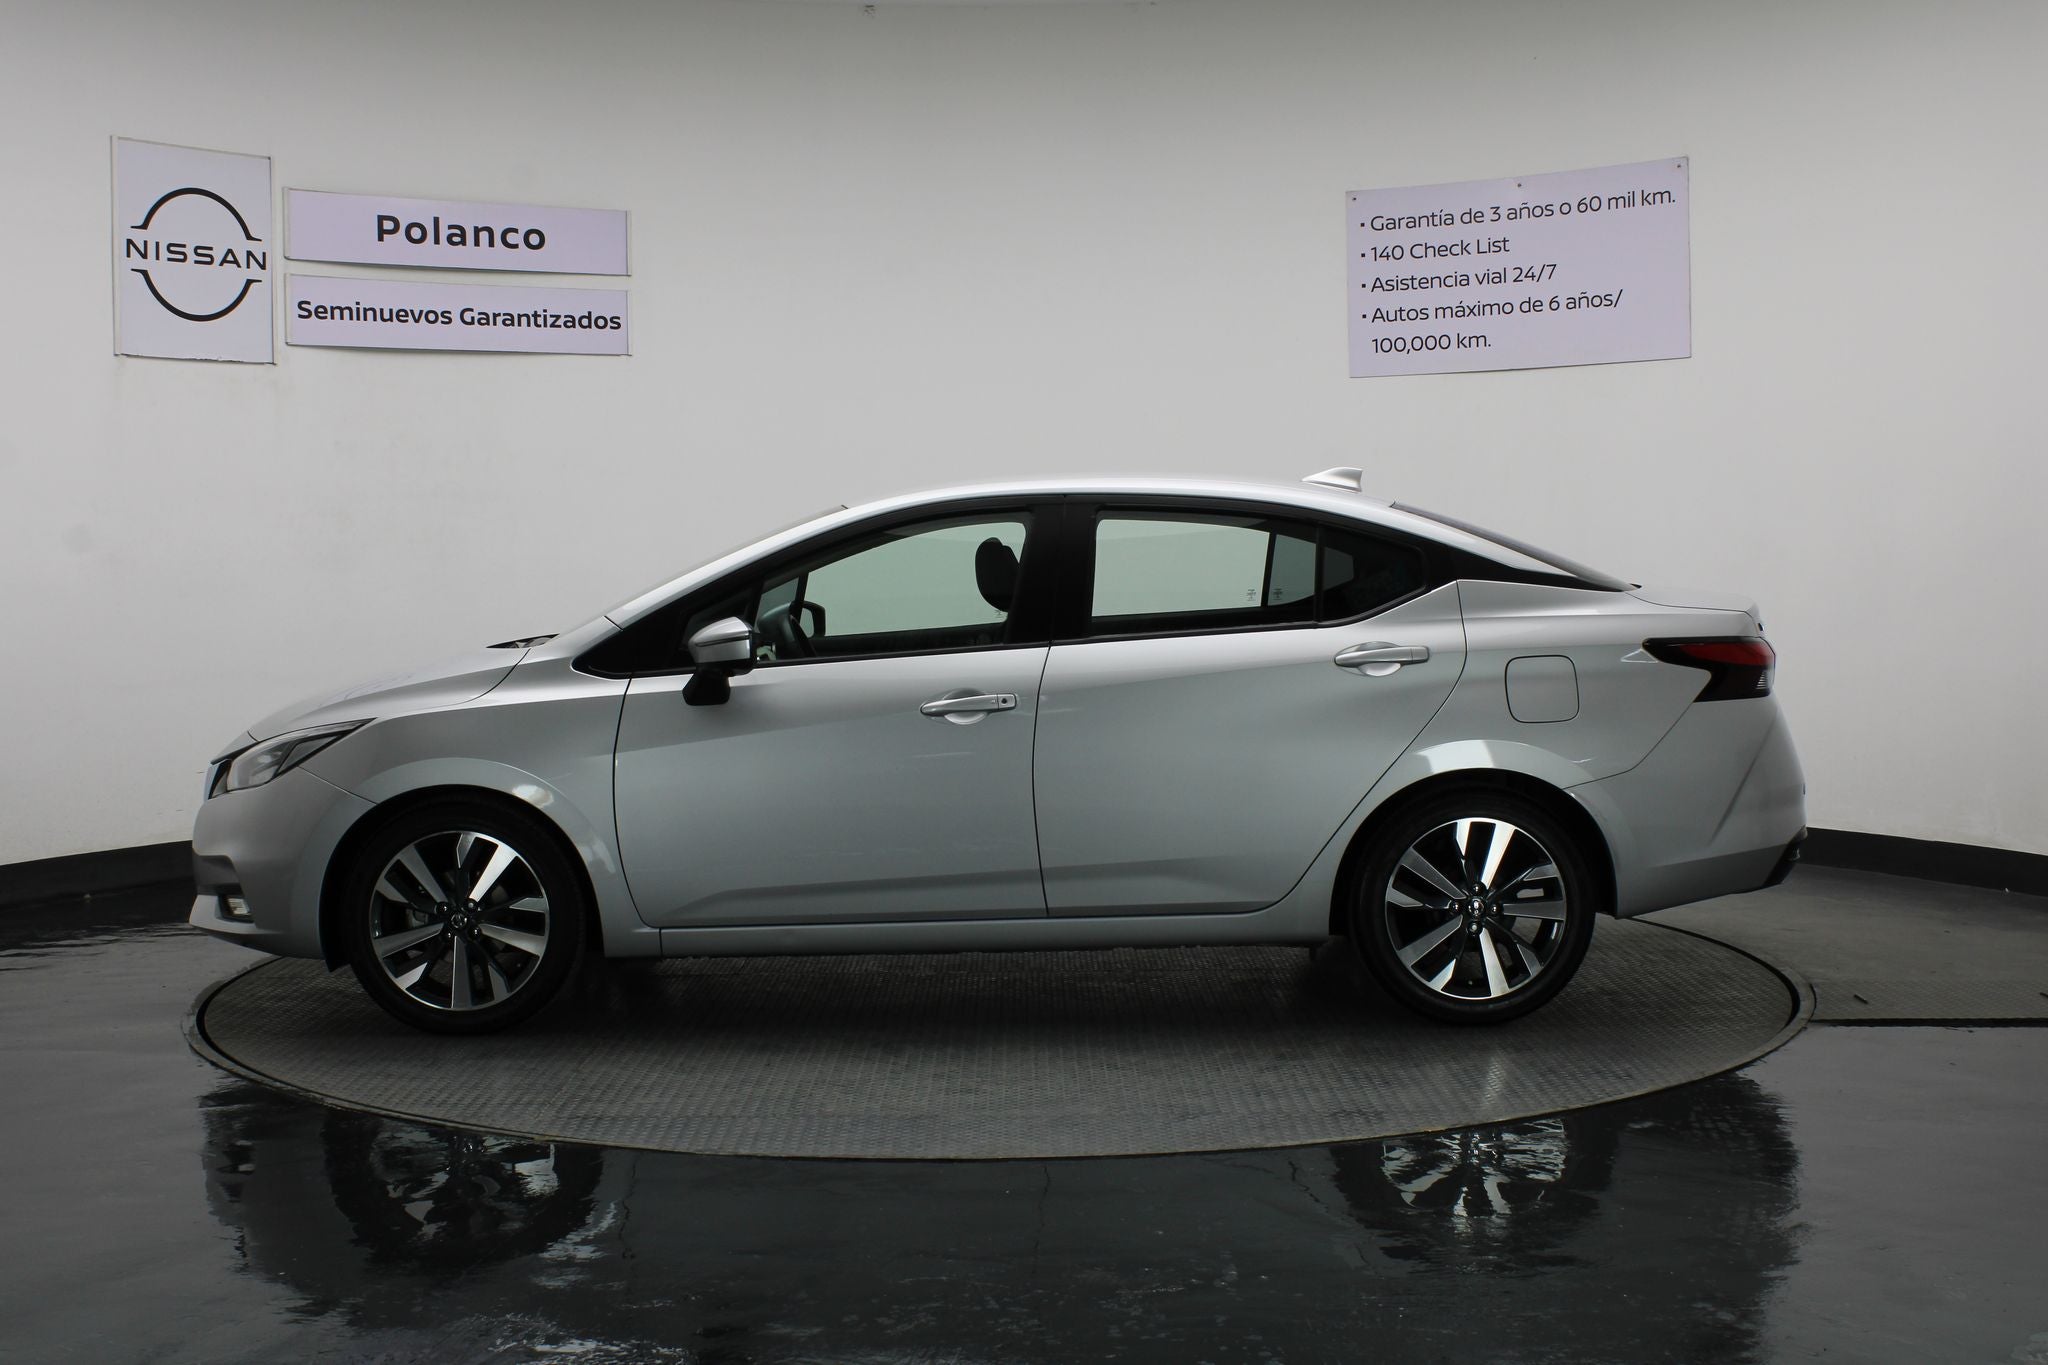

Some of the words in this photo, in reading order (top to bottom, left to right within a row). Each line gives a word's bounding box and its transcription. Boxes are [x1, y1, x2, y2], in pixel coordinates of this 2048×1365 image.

[1370, 208, 1455, 232] Garantía
[1459, 207, 1485, 225] de
[1489, 205, 1502, 223] 3
[1506, 201, 1555, 221] años
[1558, 201, 1572, 216] o
[1576, 195, 1602, 214] 60
[1607, 190, 1636, 211] mil
[1640, 189, 1676, 207] km.
[376, 214, 546, 251] Polanco
[125, 237, 267, 271] NISSAN
[1370, 244, 1405, 263] 140
[1409, 239, 1472, 260] Check
[1476, 236, 1511, 255] List
[1370, 270, 1471, 293] Asistencia
[1474, 266, 1507, 286] vial
[1512, 263, 1558, 284] 24/7
[296, 299, 453, 326] Seminuevos
[459, 307, 622, 331] Garantizados
[1371, 306, 1430, 324] Autos
[1434, 299, 1515, 320] máximo
[1518, 296, 1544, 314] de
[1548, 294, 1561, 312] 6
[1565, 288, 1624, 311] años/
[1371, 333, 1452, 355] 100,000
[1456, 332, 1492, 350] km.
